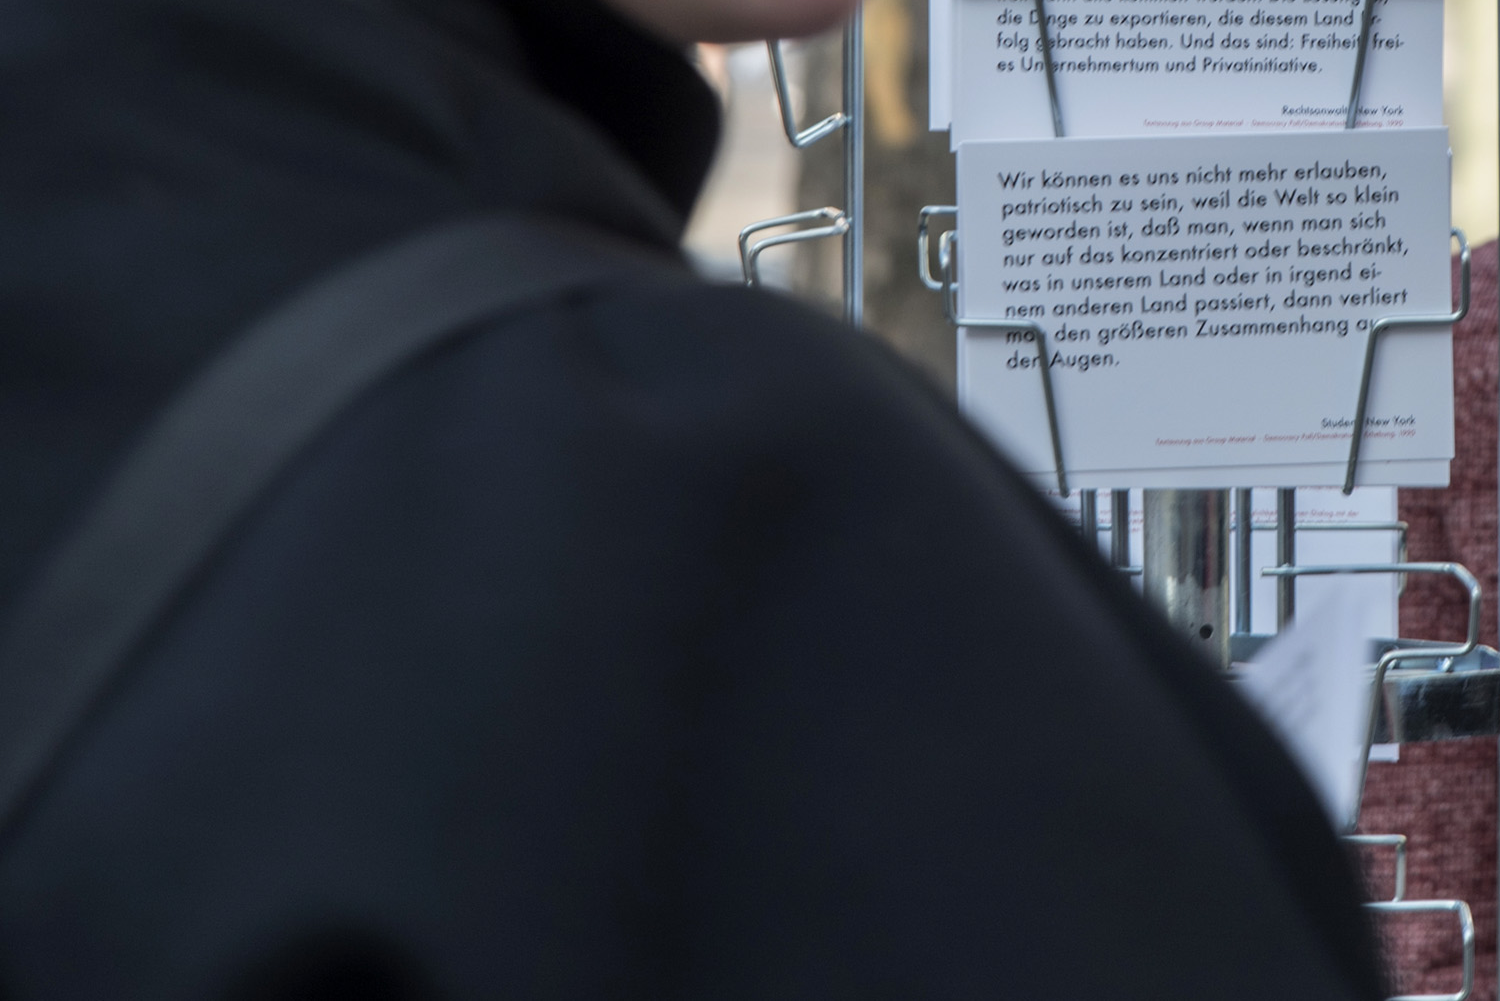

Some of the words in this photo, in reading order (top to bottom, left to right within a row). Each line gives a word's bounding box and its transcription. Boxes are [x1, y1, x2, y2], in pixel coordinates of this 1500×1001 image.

[997, 8, 1022, 25] die
[1030, 9, 1078, 29] Dnge
[1084, 15, 1103, 25] zu
[1110, 10, 1211, 29] exportieren,
[1218, 9, 1243, 25] die
[1250, 9, 1307, 26] diesem
[1314, 9, 1354, 26] Land
[997, 31, 1029, 52] folg
[1116, 32, 1173, 49] haben.
[1181, 32, 1214, 49] Und
[1221, 32, 1250, 49] das
[1256, 32, 1293, 49] sind:
[1371, 31, 1405, 49] frei-
[997, 61, 1014, 72] es
[1021, 54, 1160, 73] Unernehmertum
[1166, 56, 1196, 72] und
[1203, 57, 1322, 72] Privatinitiative.
[1382, 106, 1403, 115] York
[998, 172, 1034, 189] Wir
[1042, 170, 1112, 188] können
[1119, 174, 1140, 186] es
[1147, 172, 1179, 185] uns
[1186, 165, 1232, 184] nicht
[1239, 163, 1287, 182] mehr
[1294, 161, 1386, 180] erlauben,
[1002, 194, 1102, 217] patriotisch
[1111, 200, 1132, 212] zu
[1141, 193, 1183, 213] sein,
[1192, 189, 1230, 209] weil
[1238, 189, 1267, 207] die
[1275, 187, 1319, 206] Welt
[1327, 193, 1347, 205] so
[1355, 185, 1399, 203] klein
[1002, 220, 1100, 244] geworden
[1108, 221, 1133, 240] ist,
[1141, 216, 1180, 236] daß
[1188, 222, 1234, 237] man,
[1243, 220, 1293, 232] wenn
[1302, 218, 1342, 231] man
[1350, 210, 1386, 229] sich
[1004, 254, 1035, 267] nur
[1042, 246, 1073, 265] auf
[1080, 245, 1114, 264] das
[1121, 244, 1238, 263] konzentriert
[1245, 240, 1290, 258] oder
[1298, 238, 1408, 257] beschränkt,
[1003, 280, 1040, 292] was
[1047, 274, 1064, 291] in
[1072, 276, 1151, 290] unserem
[1160, 268, 1205, 287] Land
[1213, 266, 1259, 285] oder
[1266, 266, 1282, 284] in
[1290, 263, 1352, 287] irgend
[1359, 268, 1381, 280] ei-
[1006, 305, 1045, 318] nem
[1053, 297, 1133, 316] anderen
[1141, 294, 1187, 313] Land
[1195, 293, 1275, 316] passiert,
[1283, 289, 1332, 308] dann
[1340, 287, 1408, 306] verliert
[1006, 329, 1041, 343] ma
[1054, 323, 1090, 342] den
[1098, 320, 1187, 345] größeren
[1196, 316, 1348, 337] Zusammenhang
[1049, 348, 1120, 372] Augen.
